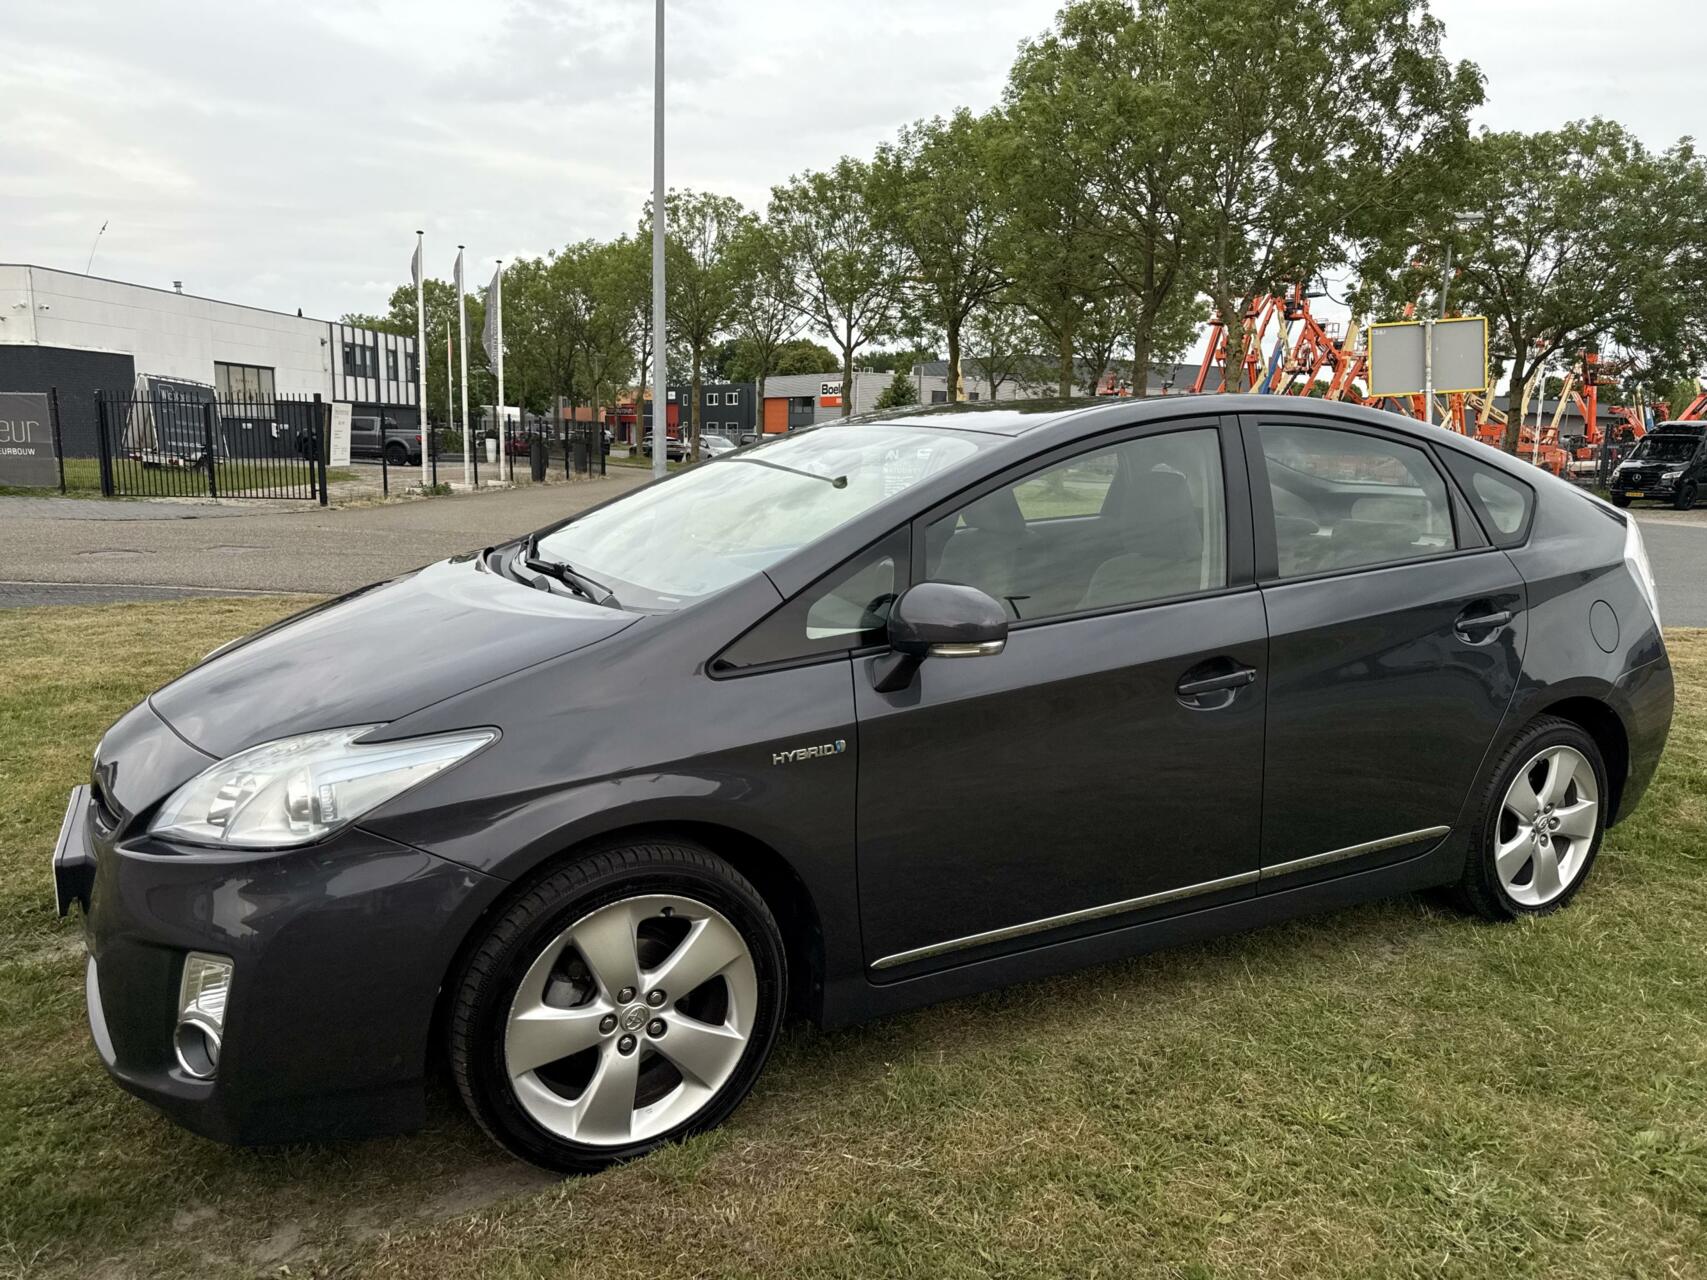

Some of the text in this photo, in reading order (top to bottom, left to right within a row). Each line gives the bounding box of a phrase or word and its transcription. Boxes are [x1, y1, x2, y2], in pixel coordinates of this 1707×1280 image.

[821, 383, 843, 395] Boel
[0, 420, 40, 443] eur
[772, 743, 836, 766] HYBRID
